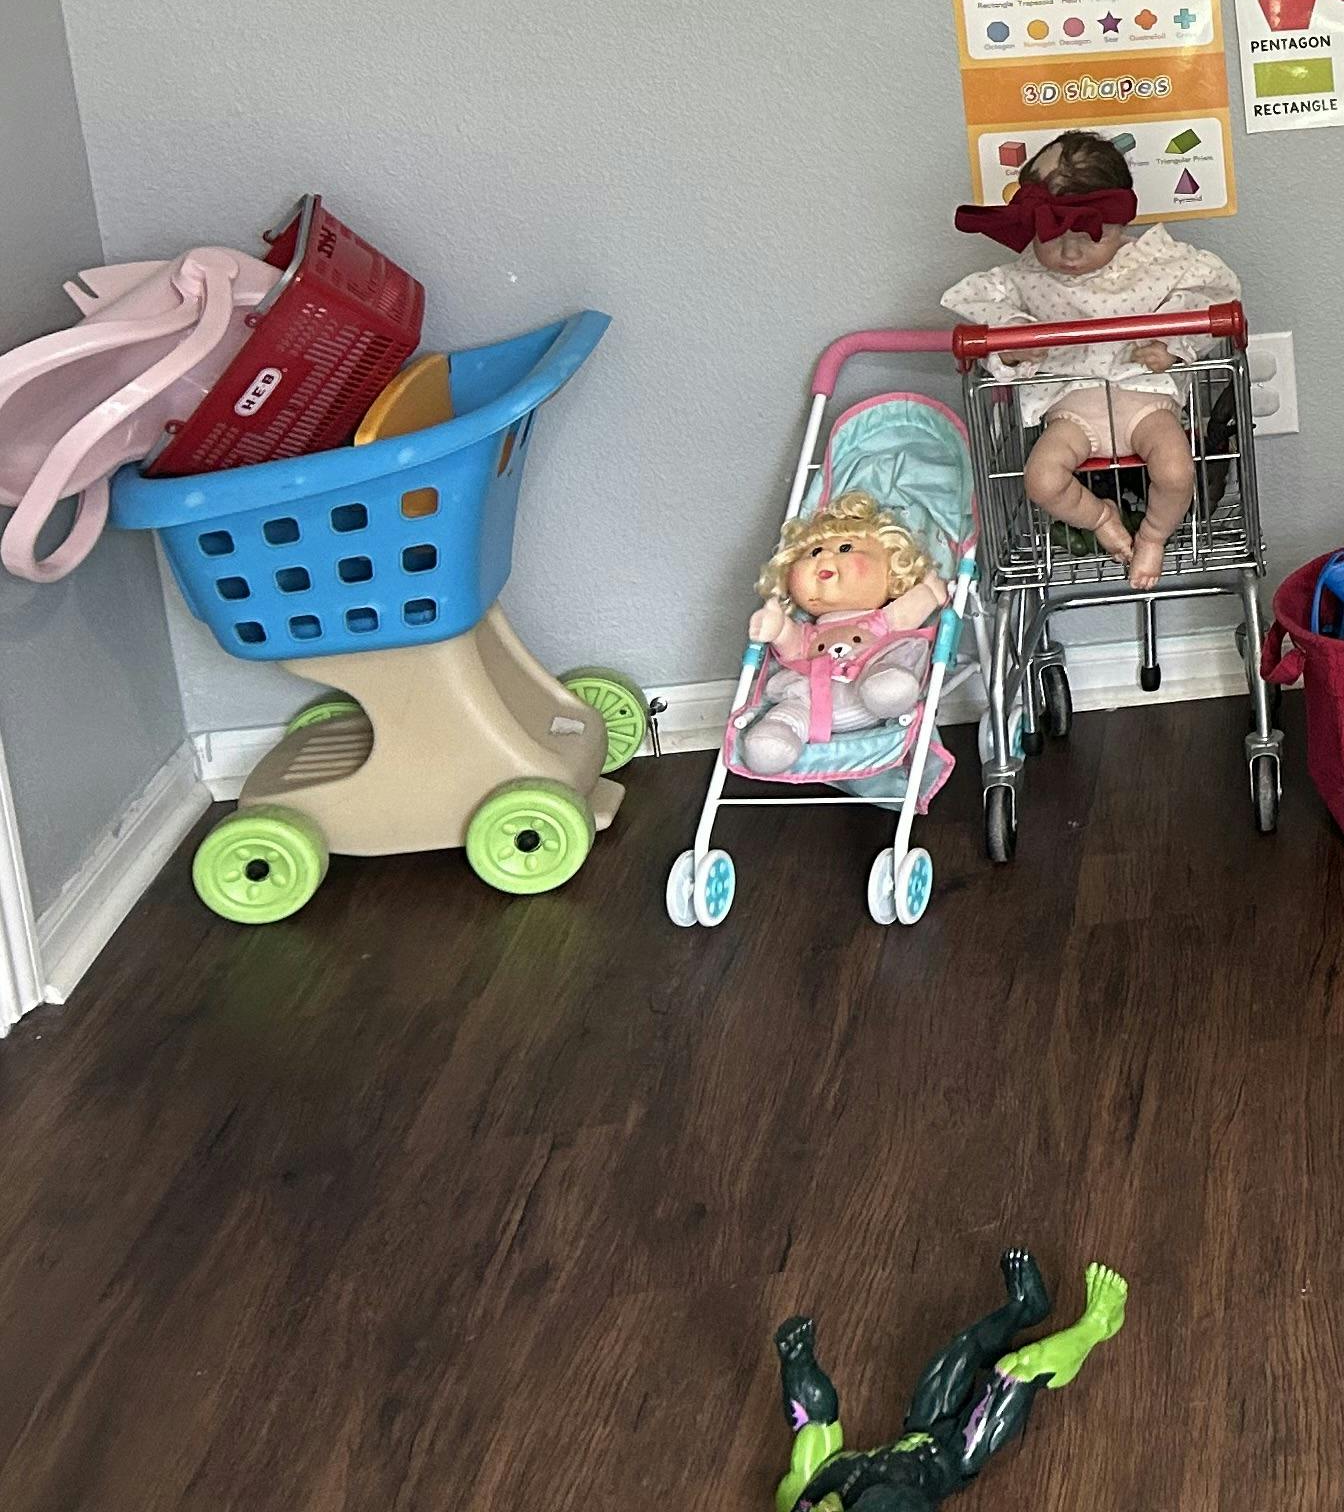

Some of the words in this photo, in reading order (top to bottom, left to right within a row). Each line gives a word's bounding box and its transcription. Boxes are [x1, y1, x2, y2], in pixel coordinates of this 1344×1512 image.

[1251, 35, 1331, 53] PENTAGON
[1024, 84, 1058, 104] 3D
[1064, 76, 1170, 101] shapes
[1254, 99, 1337, 117] RECTANGLE
